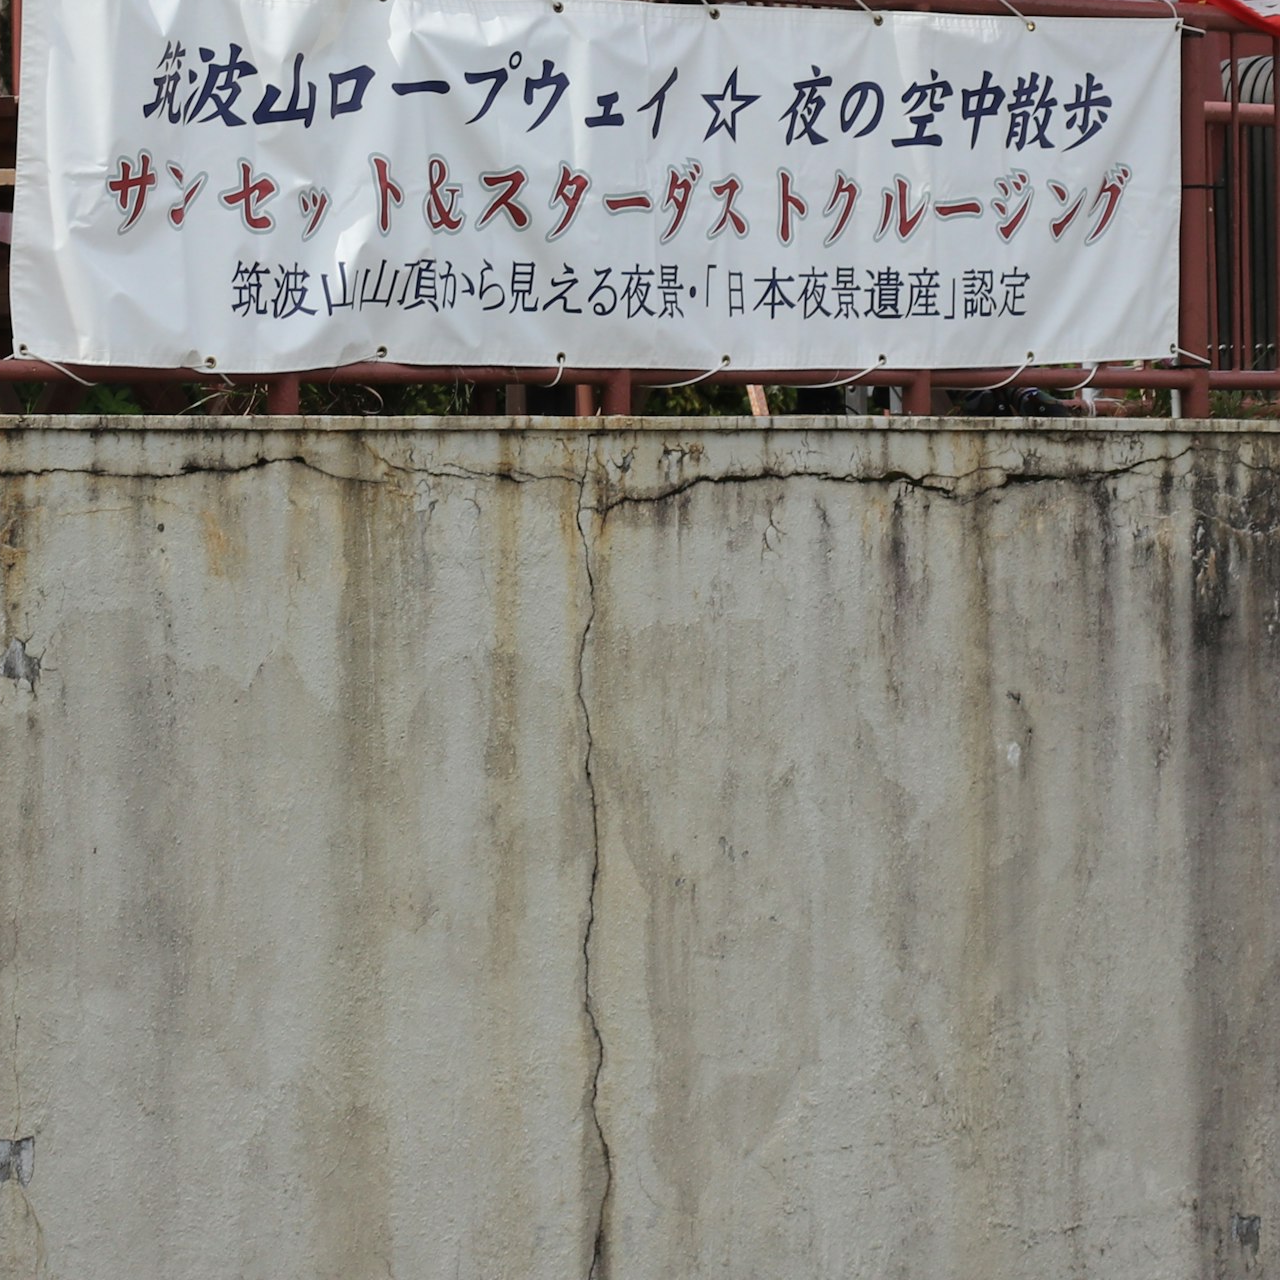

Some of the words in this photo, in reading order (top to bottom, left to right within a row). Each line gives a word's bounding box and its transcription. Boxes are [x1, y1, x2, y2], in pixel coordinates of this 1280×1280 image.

[107, 148, 1131, 246] サンセット&スターダストクルージング
